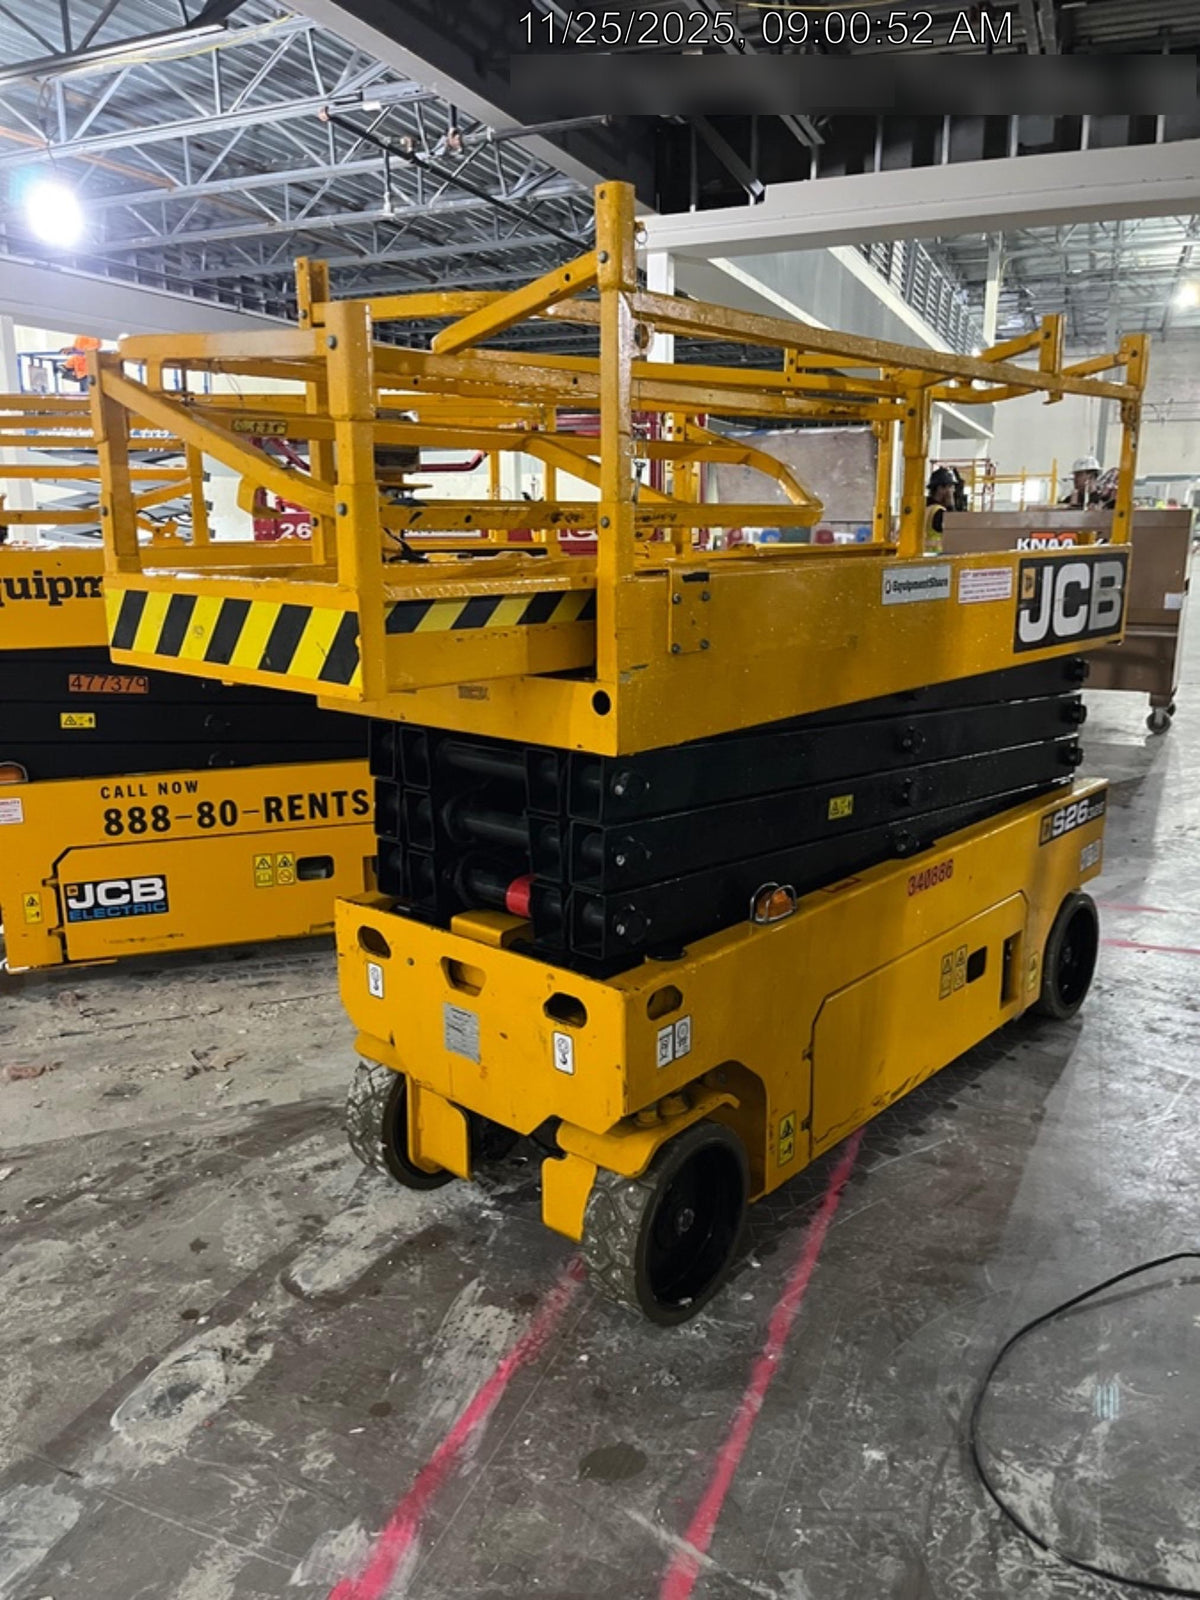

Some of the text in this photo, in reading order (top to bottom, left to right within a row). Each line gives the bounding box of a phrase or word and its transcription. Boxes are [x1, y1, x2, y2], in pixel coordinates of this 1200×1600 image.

[0, 571, 103, 606] uipm
[1018, 561, 1124, 642] JCB
[70, 674, 148, 692] 477379
[100, 779, 199, 800] CALL NOW
[103, 789, 369, 836] 888-80-RENTS
[1052, 799, 1090, 836] S26
[68, 877, 165, 909] JCB
[68, 902, 168, 922] ELECTRIC
